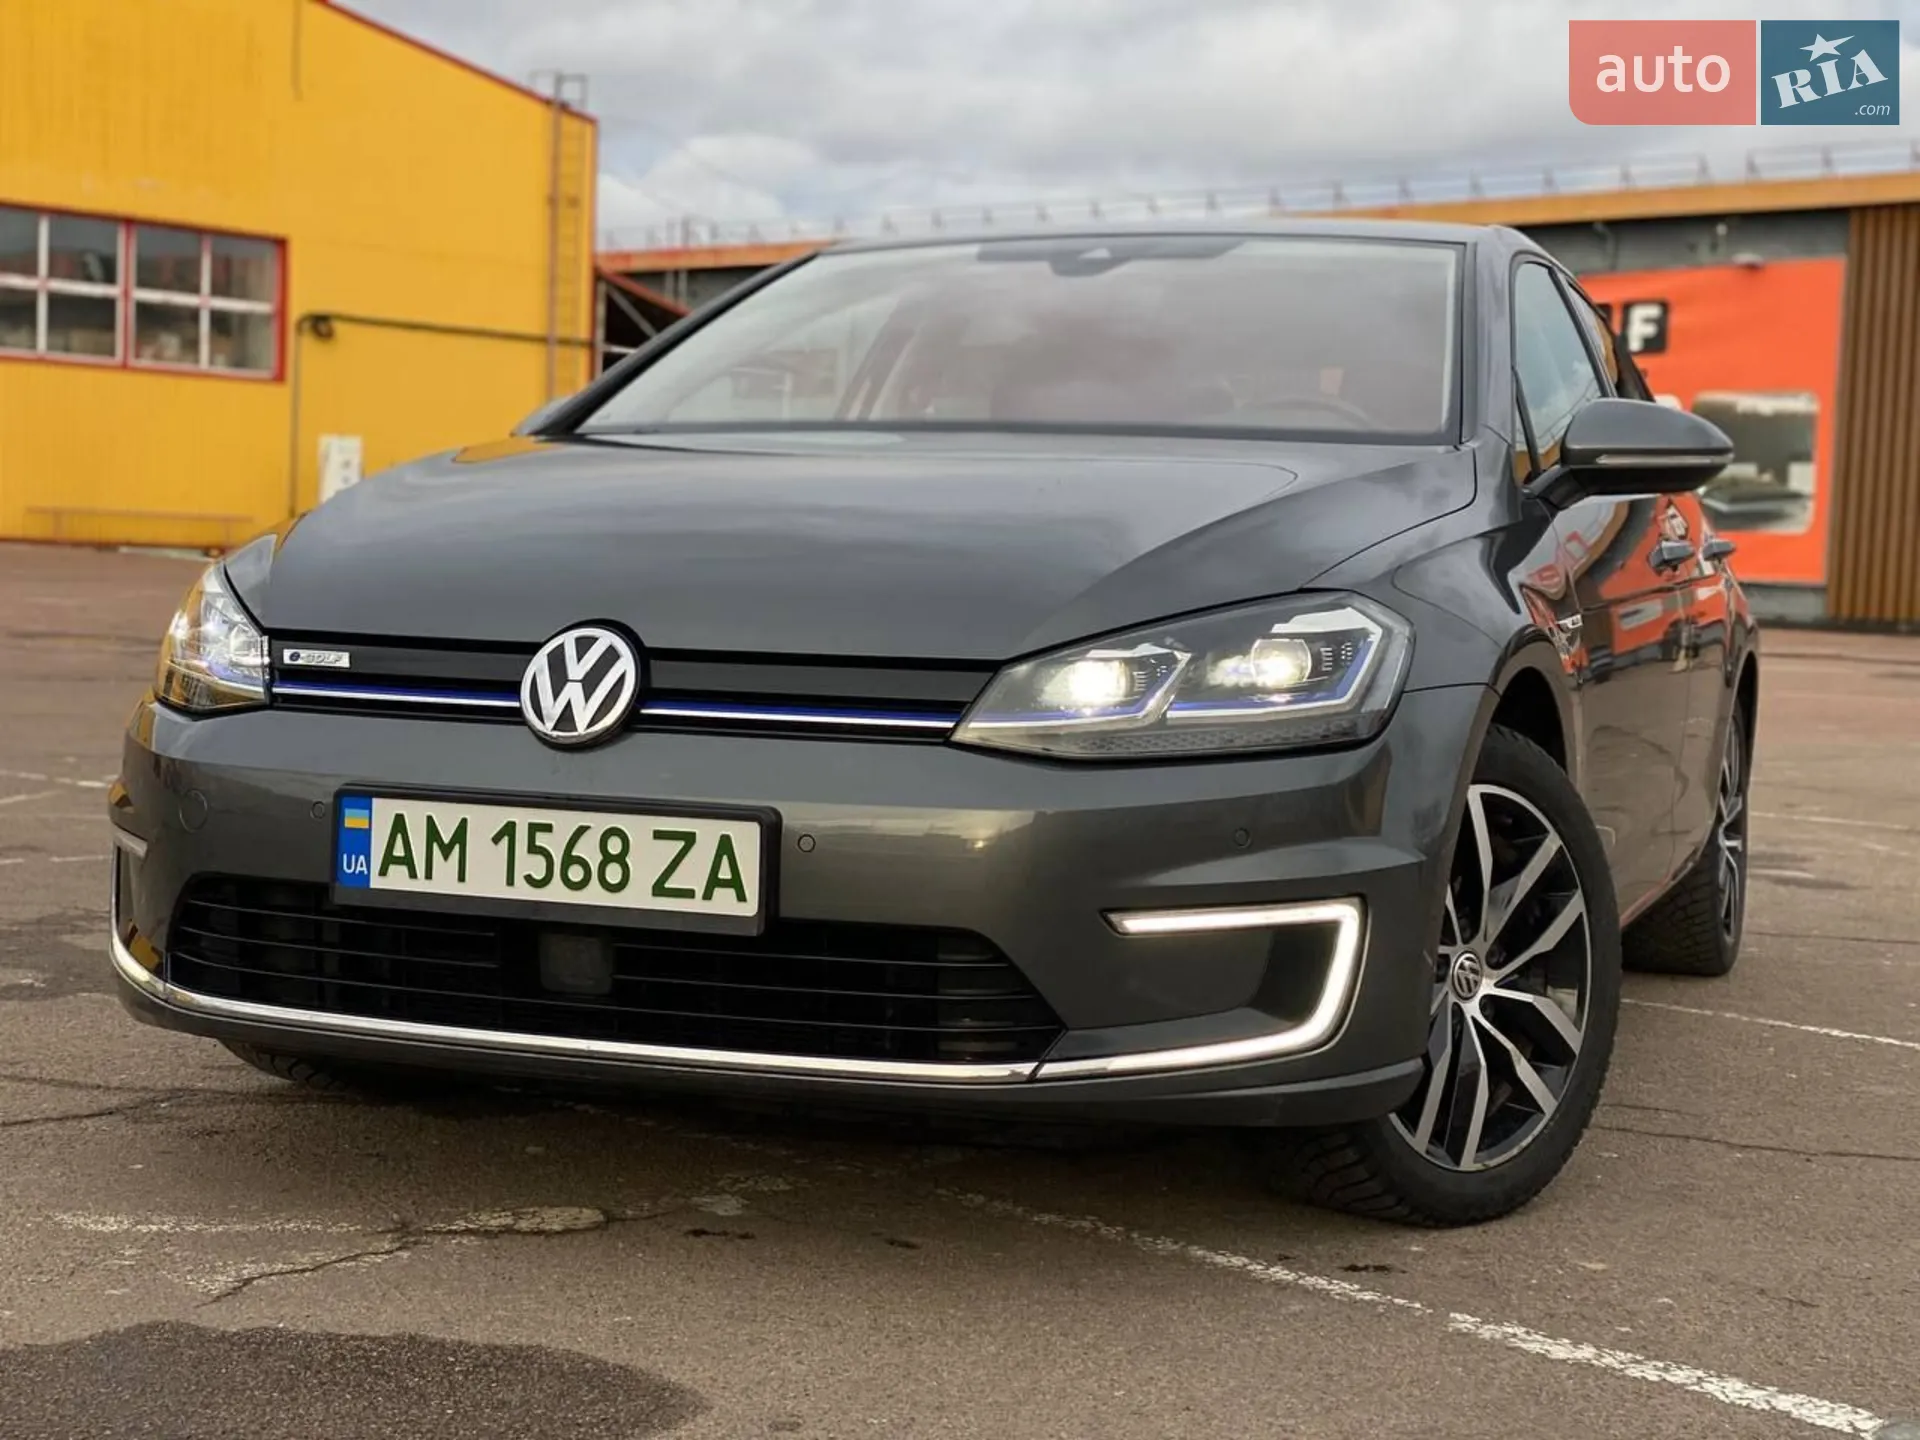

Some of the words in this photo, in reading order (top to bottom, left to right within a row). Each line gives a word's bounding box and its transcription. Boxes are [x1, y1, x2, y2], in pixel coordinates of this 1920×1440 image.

[343, 854, 368, 875] UA
[378, 813, 468, 883] AM
[491, 820, 632, 893] 1568
[651, 829, 748, 902] ZA
